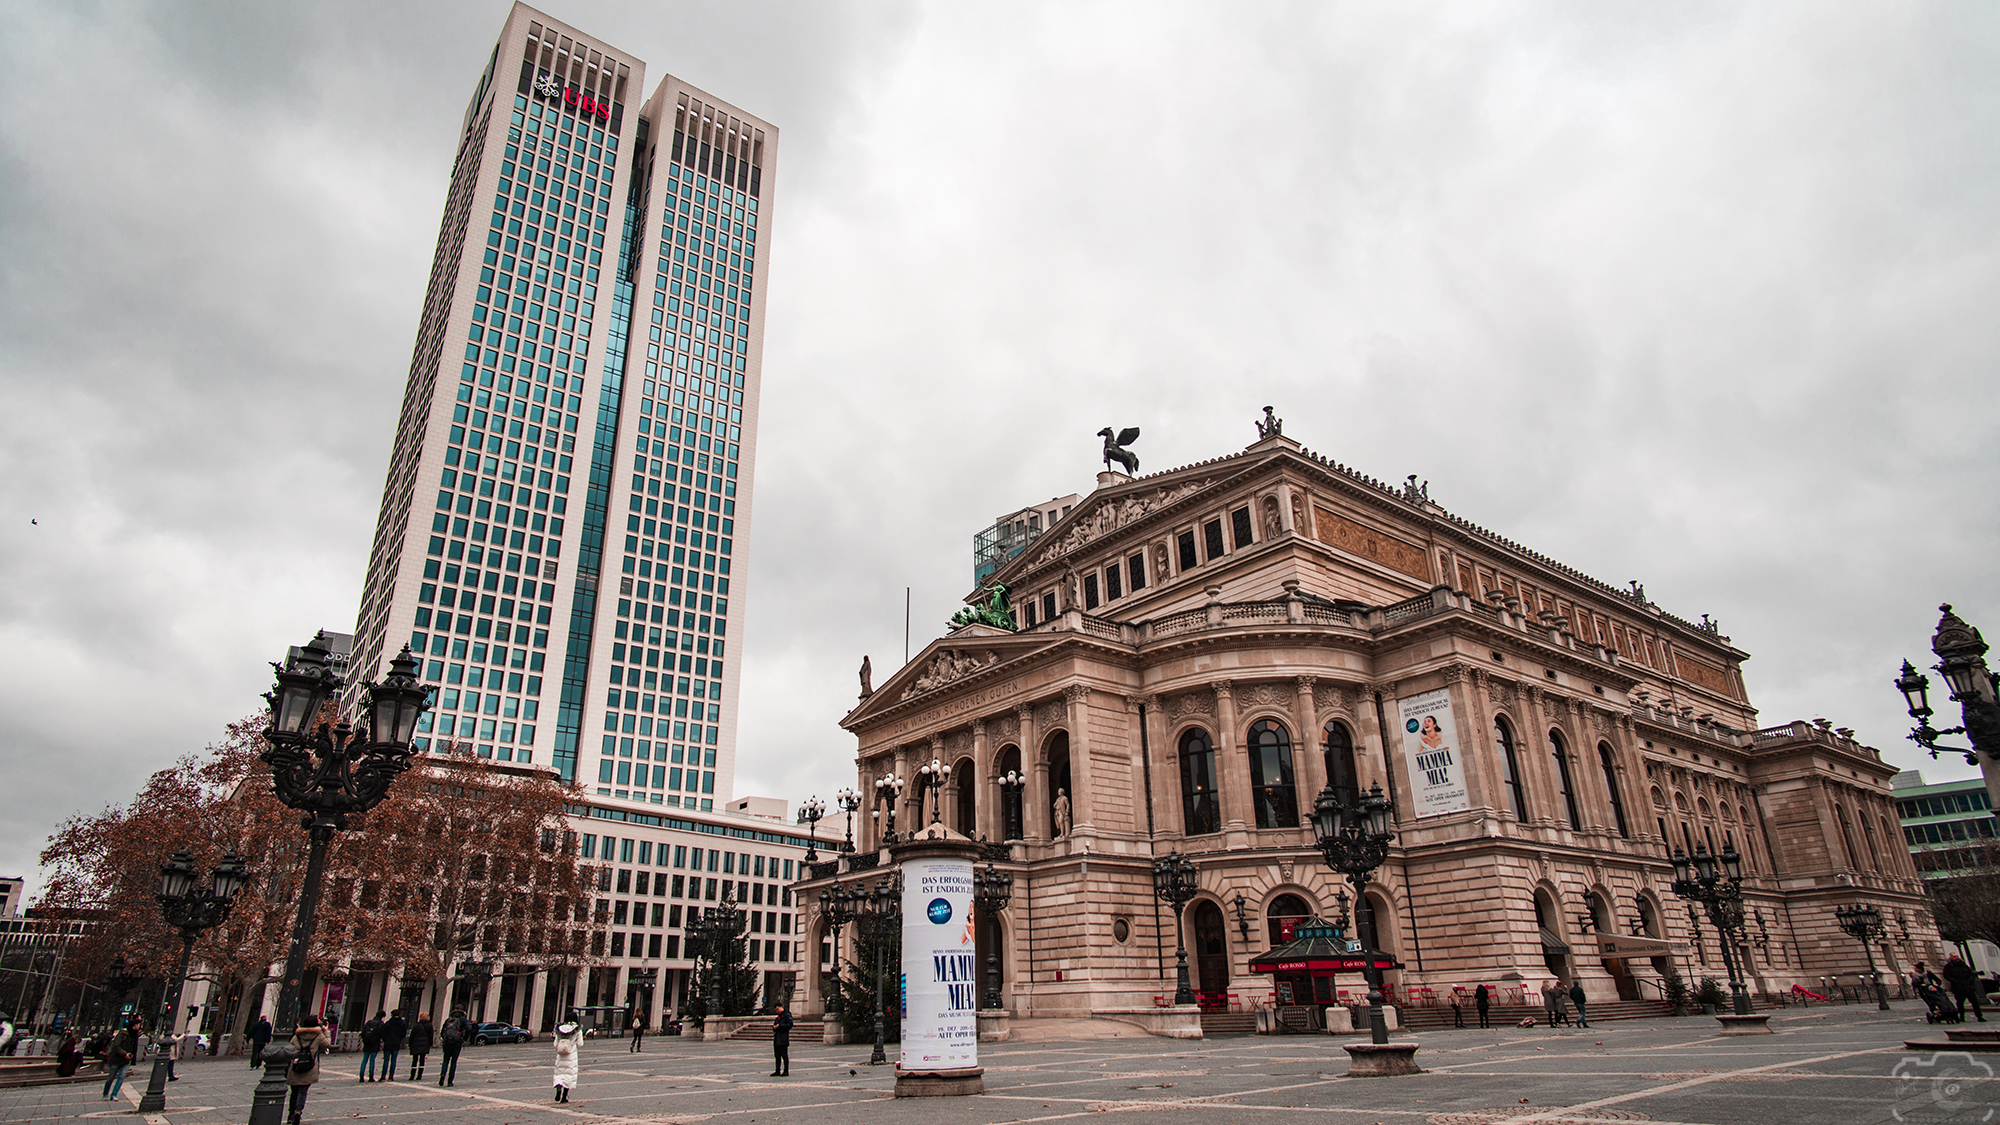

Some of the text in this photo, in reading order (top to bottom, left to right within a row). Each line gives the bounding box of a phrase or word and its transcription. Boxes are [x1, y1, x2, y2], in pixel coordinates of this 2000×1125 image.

[564, 86, 610, 120] UBS
[911, 709, 942, 728] WAHREN
[943, 693, 987, 716] SCHOENEN
[988, 680, 1021, 700] GUTEN.
[1416, 750, 1454, 772] MAMMA
[1426, 767, 1449, 786] MIA!
[922, 876, 938, 885] DAS
[922, 886, 934, 894] IST
[936, 885, 966, 893] ENDLICH
[933, 955, 975, 982] MAMM
[948, 983, 974, 1011] MIA!
